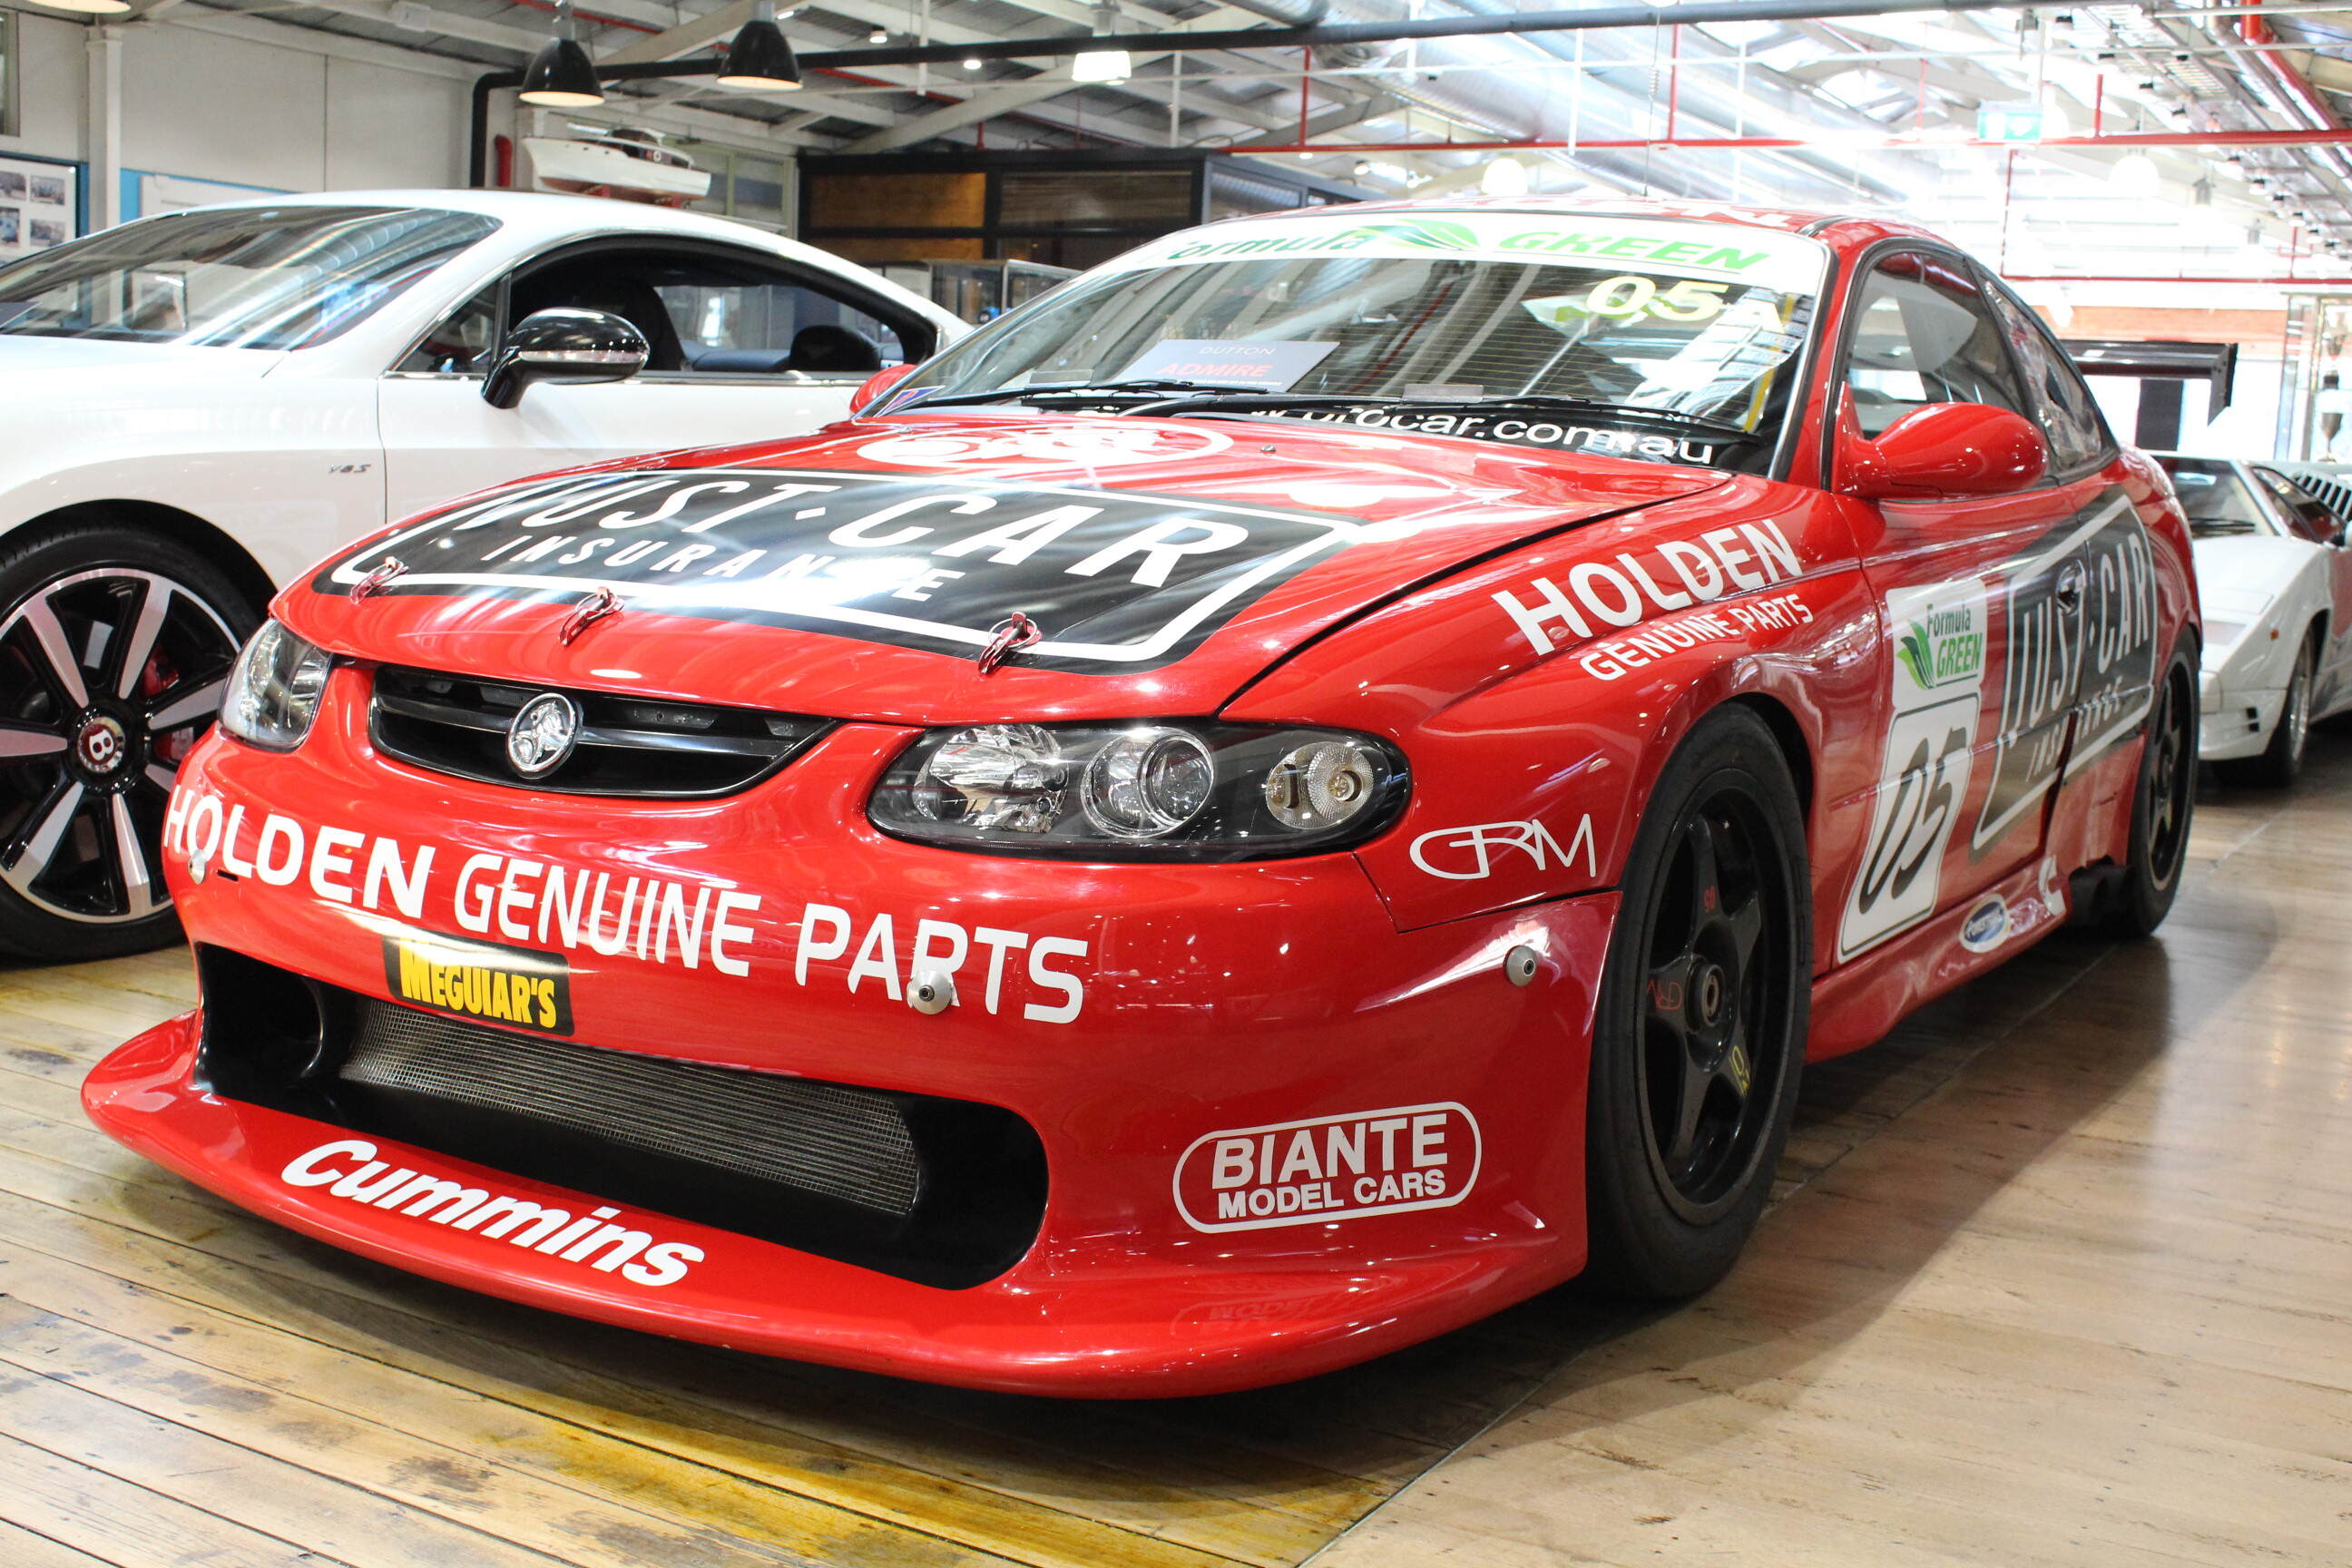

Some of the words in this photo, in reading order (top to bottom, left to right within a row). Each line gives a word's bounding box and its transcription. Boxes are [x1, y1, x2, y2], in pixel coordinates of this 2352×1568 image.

[1165, 228, 1379, 260] ormula
[1499, 231, 1770, 270] GREEN
[1586, 276, 1729, 321] 05
[1156, 364, 1274, 377] ADMIRE
[1198, 346, 1278, 356] DUTTON
[481, 535, 966, 602] INSURANE
[828, 494, 1250, 589] CAR
[1491, 519, 1804, 656] HOLDEN
[1926, 603, 1971, 638] Formula
[2098, 532, 2149, 674] CAR
[1580, 609, 1742, 681] GENUINE
[1730, 593, 1814, 633] PARTS
[1936, 632, 1983, 679] GREEN
[1858, 727, 1967, 915] 05
[163, 784, 436, 918] HOLDEN
[455, 854, 762, 977] GENUINE
[795, 903, 1089, 1024] PARTS
[399, 937, 557, 1029] MEGUIAR'S
[1211, 1112, 1448, 1190] BIANTE
[280, 1139, 705, 1287] Cummins
[1218, 1181, 1344, 1220] MODEL
[1353, 1169, 1447, 1205] CARS
